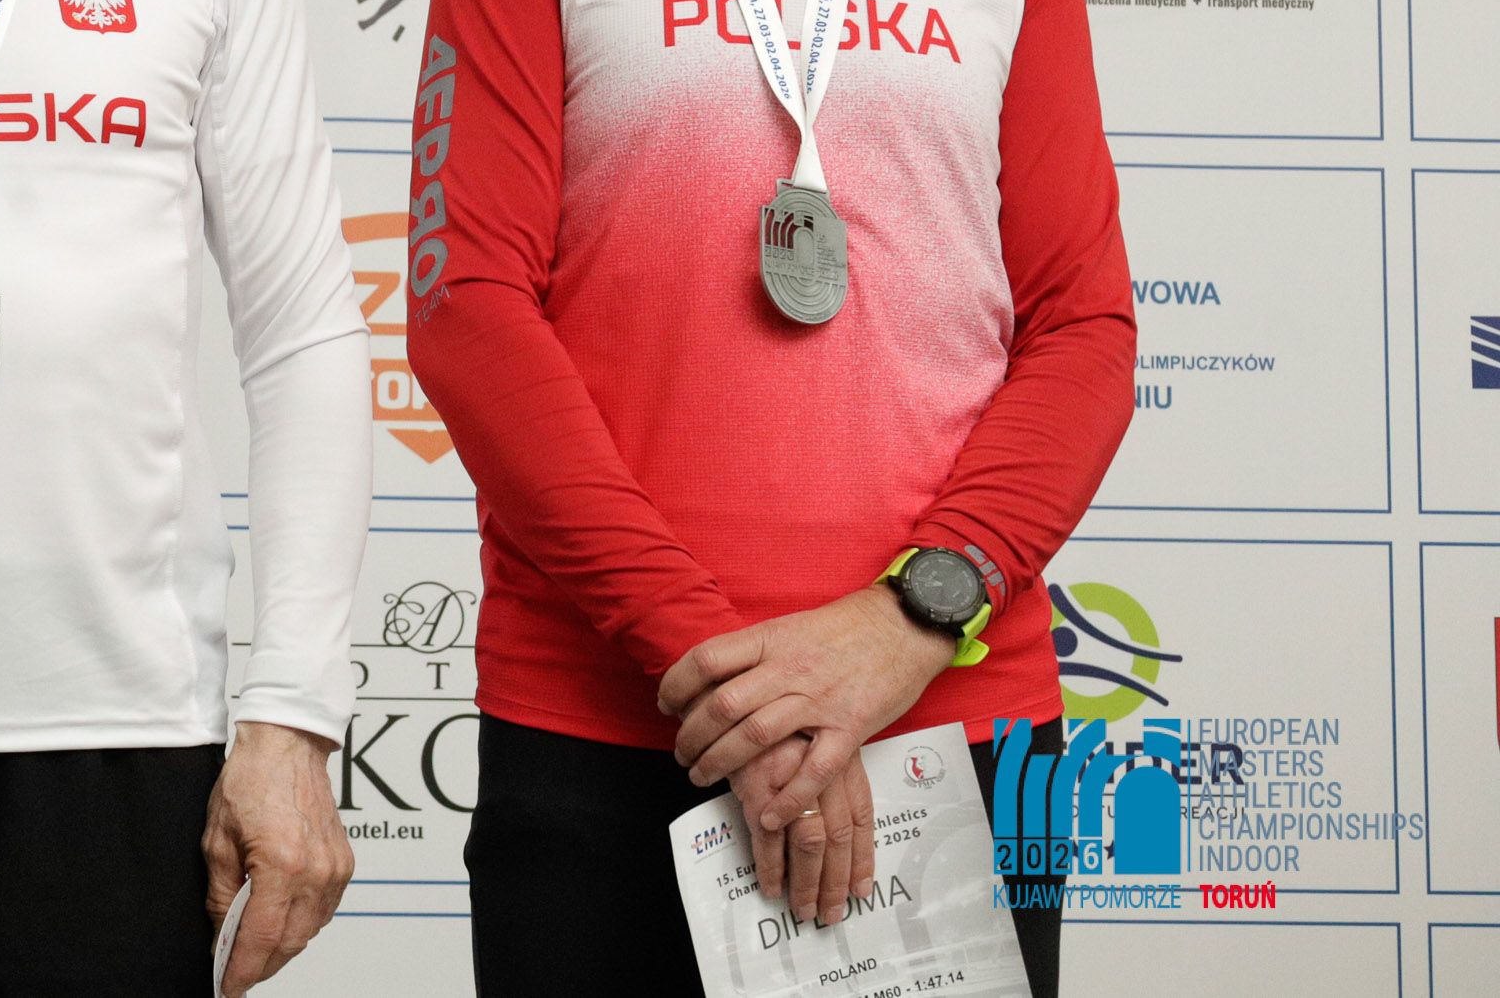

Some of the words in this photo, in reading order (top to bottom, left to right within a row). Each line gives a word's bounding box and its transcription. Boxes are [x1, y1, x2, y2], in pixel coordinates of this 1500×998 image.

[754, 7, 792, 100] 27.03-02.04.2026
[874, 808, 928, 831] hletics
[693, 822, 733, 855] EMA
[884, 827, 921, 846] 2026
[716, 873, 734, 888] 15.
[819, 958, 877, 986] POLAND
[915, 971, 965, 992] 1:47.14
